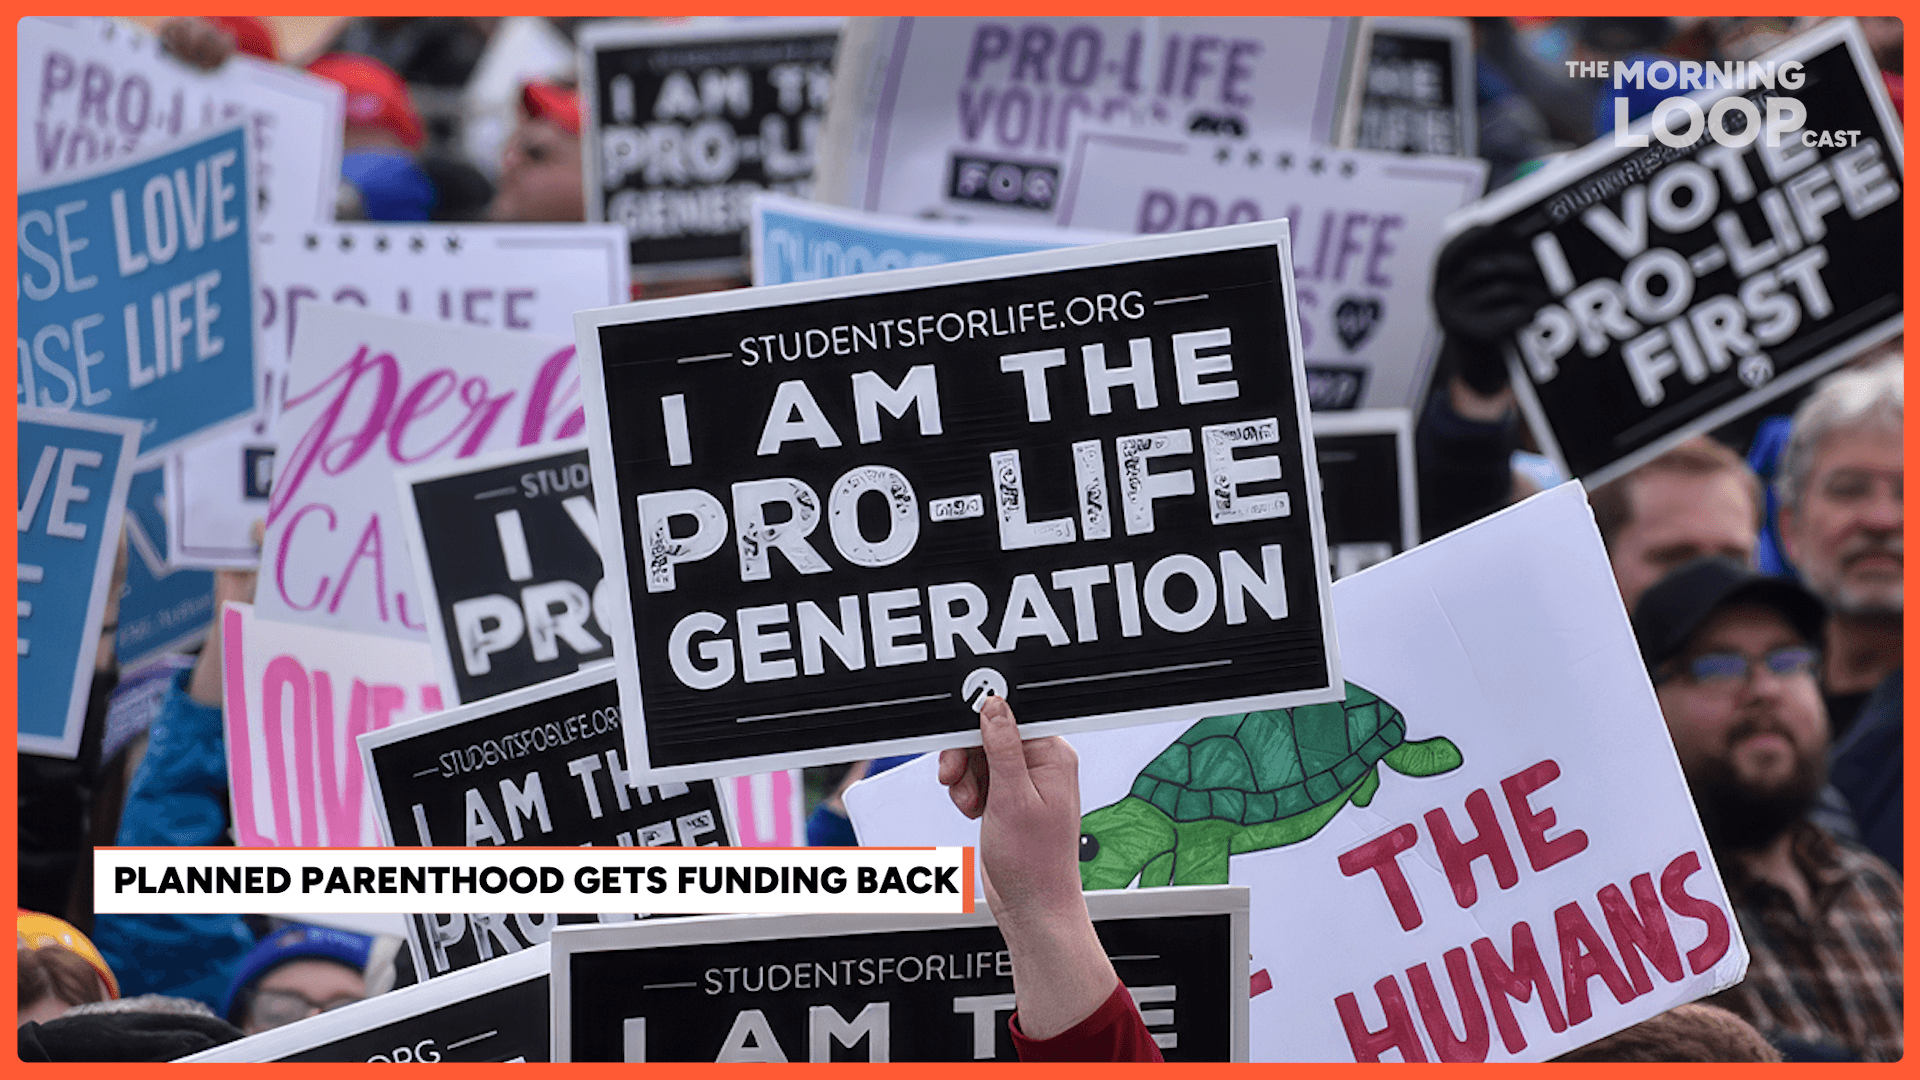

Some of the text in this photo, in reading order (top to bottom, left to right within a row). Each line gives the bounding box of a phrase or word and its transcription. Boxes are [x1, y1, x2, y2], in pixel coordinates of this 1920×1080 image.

[17, 149, 240, 302] SE LOVE
[1516, 136, 1902, 384] PRO-LIFE
[1531, 230, 1577, 296] I
[124, 269, 225, 390] LIFE
[661, 327, 1240, 466] I AM THE
[739, 289, 1146, 368] STUDENTSFORLIFE.ORG
[1620, 244, 1835, 408] FIRST
[495, 508, 533, 582] I
[636, 417, 1292, 594] PRO-LIFE
[667, 543, 1290, 691] GENERATION
[224, 608, 406, 847] LOV
[465, 771, 554, 847] AM
[567, 749, 691, 820] TH
[1338, 759, 1590, 933] THE
[1334, 850, 1731, 1063] HUMANS
[714, 1001, 891, 1063] AM
